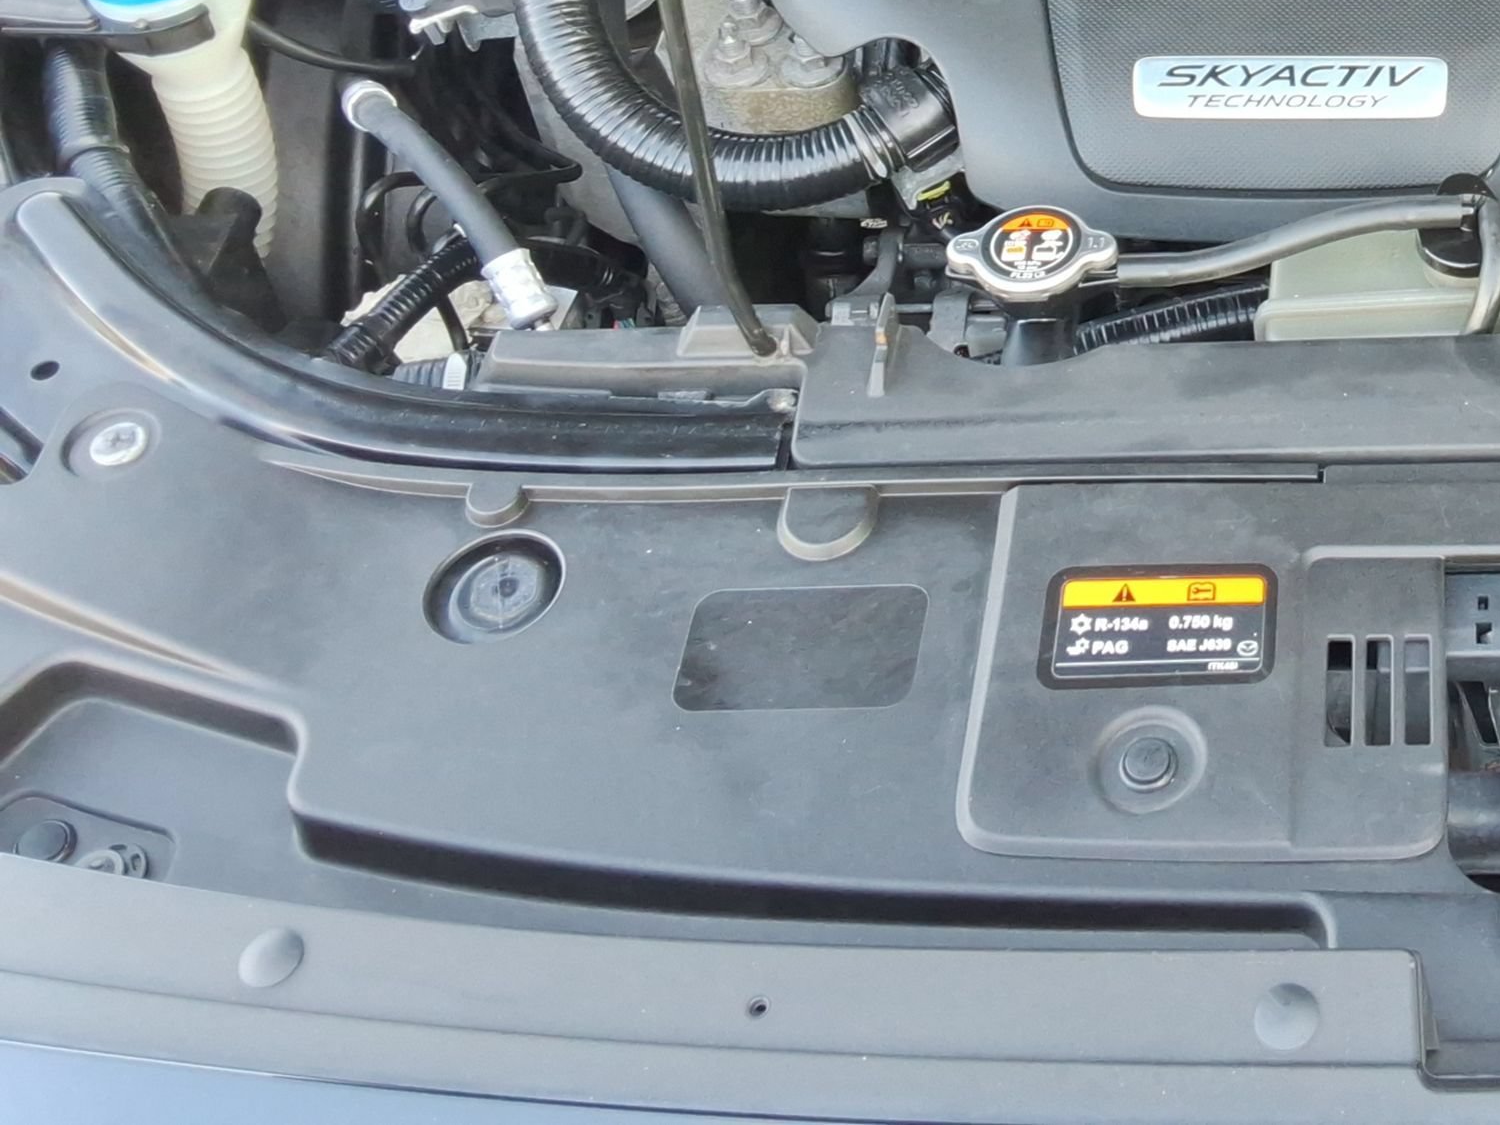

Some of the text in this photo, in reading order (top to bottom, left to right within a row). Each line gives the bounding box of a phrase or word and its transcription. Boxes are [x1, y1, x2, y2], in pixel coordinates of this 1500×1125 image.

[1158, 64, 1425, 87] SKYACTIV
[1186, 94, 1388, 108] TECHNOLOGY
[1087, 236, 1106, 249] 1.1
[1094, 616, 1149, 632] R-134a
[1212, 614, 1234, 632] kg
[1091, 637, 1232, 655] PAG SAE J639
